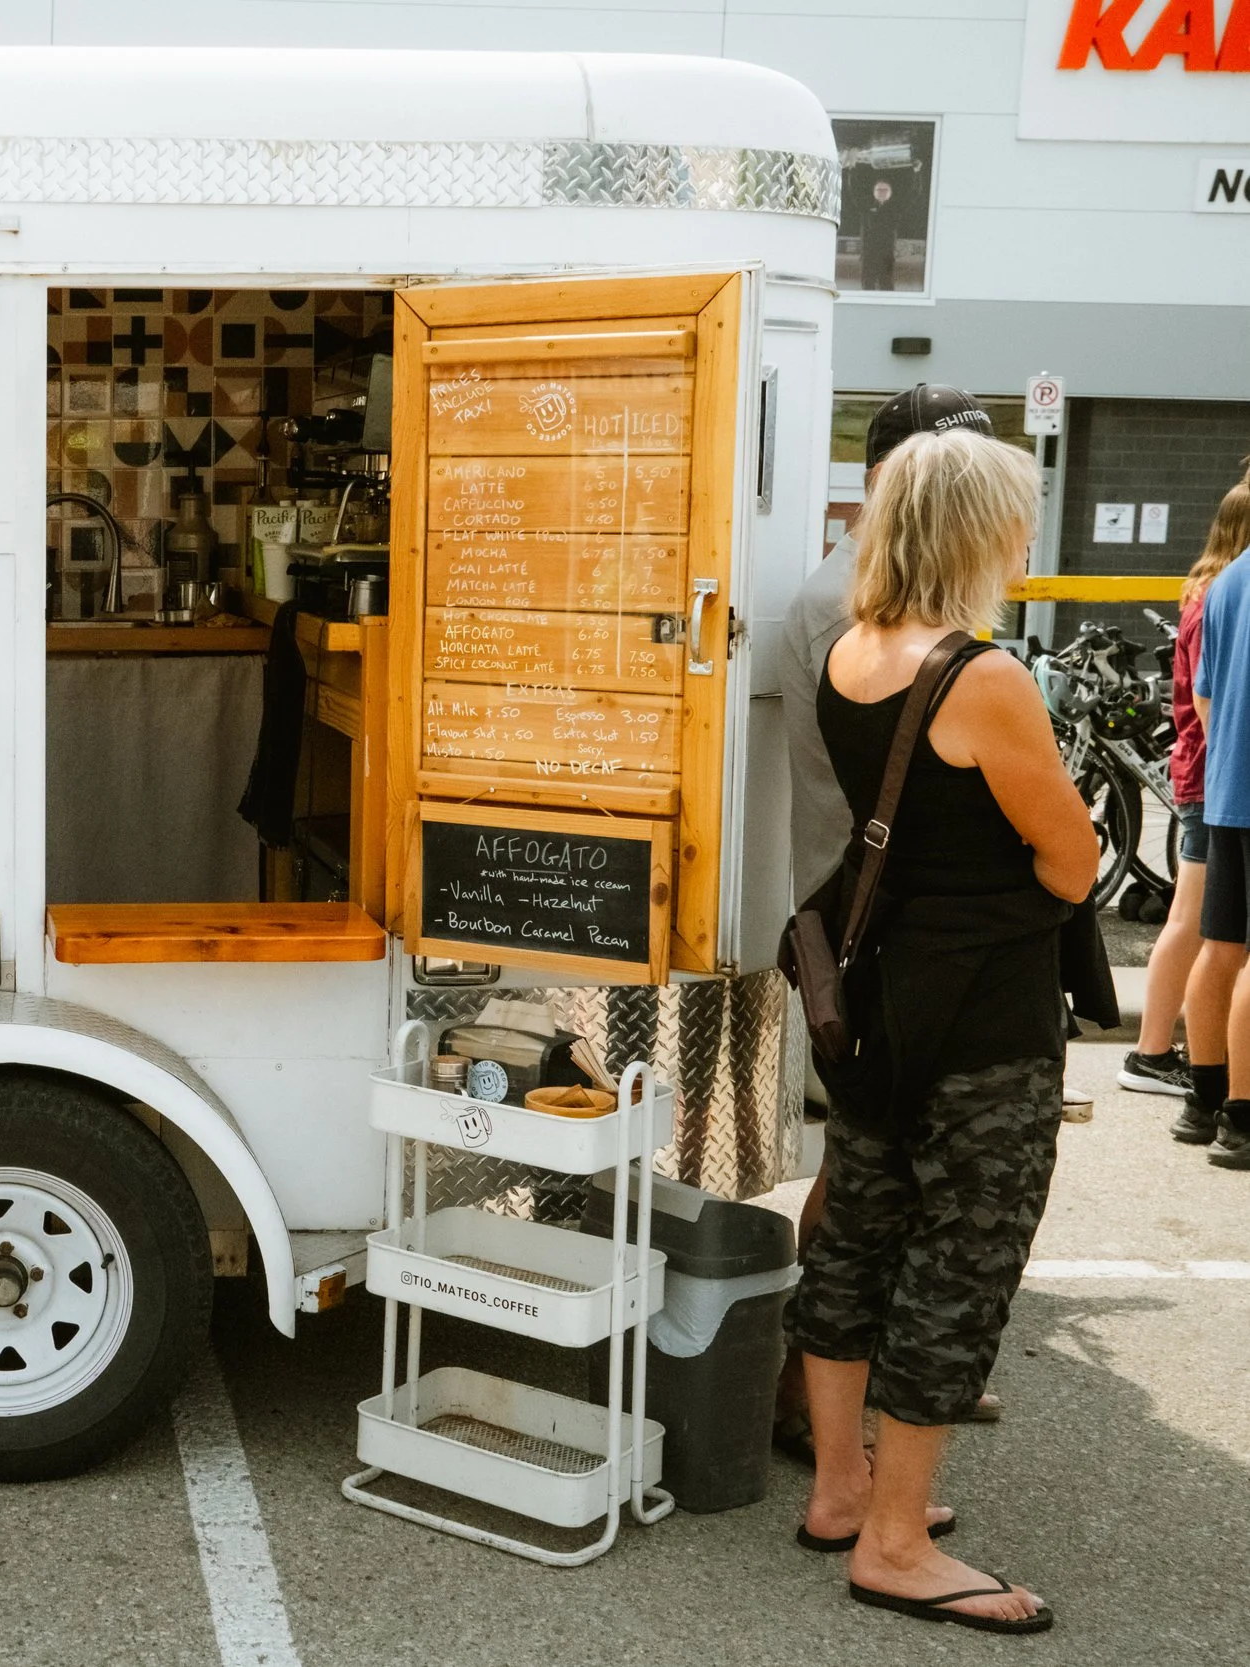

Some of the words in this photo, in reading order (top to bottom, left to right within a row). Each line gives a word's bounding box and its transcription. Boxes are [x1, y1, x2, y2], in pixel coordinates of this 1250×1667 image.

[1208, 168, 1250, 203] N
[430, 368, 481, 401] PRICES
[531, 383, 546, 395] TIO
[433, 380, 494, 416] INCLUDE
[453, 398, 492, 424] TAX!
[584, 414, 623, 435] HOT
[631, 412, 679, 436] ICED
[935, 410, 991, 430] SHIMA
[539, 424, 572, 441] COFFEE
[444, 465, 526, 480] AMERICANO
[595, 465, 607, 479] 5
[635, 465, 671, 479] 5.50
[642, 479, 654, 493] 7
[443, 497, 525, 512] CAPPUCCINO
[254, 509, 295, 525] Pacific
[453, 513, 521, 526] CORTADO
[585, 513, 614, 525] 4.50
[442, 528, 478, 541] FLAT
[485, 528, 526, 541] WHITE
[461, 547, 508, 559] MOCHA
[581, 548, 615, 559] 6.75
[632, 547, 666, 560] 7.50
[449, 563, 481, 575] CHAI
[592, 563, 601, 577] 6
[643, 565, 653, 579] 7
[446, 579, 497, 592] MATCHA
[630, 583, 661, 595] 7.50
[446, 595, 495, 607] LONDON
[506, 596, 530, 608] FOG
[580, 598, 611, 609] 5.50
[479, 611, 549, 625] CHOCOLATE
[445, 625, 514, 639] AFFOGATO
[578, 629, 609, 640] 6.50
[440, 640, 499, 654] HORCHATA
[572, 647, 602, 660] 6.75
[630, 650, 656, 663] 7.50
[434, 656, 465, 669] SPICY
[471, 659, 518, 670] COCONUT
[576, 664, 605, 675] 6.75
[630, 666, 657, 678] 7.50
[506, 682, 576, 700] EXTRAS
[452, 701, 478, 717] Milk
[556, 707, 605, 725] Espresso
[620, 710, 659, 724] 3.00
[427, 722, 468, 739] Flavour
[553, 726, 588, 739] Extra
[593, 728, 619, 742] Shot
[631, 730, 659, 743] 1.50
[427, 742, 462, 758] Misto
[536, 758, 560, 775] NO
[570, 759, 623, 775] DECAF
[476, 835, 607, 871] AFFOGATO
[570, 876, 588, 887] ice
[594, 880, 630, 891] cream
[521, 920, 575, 942] Caramel
[587, 926, 629, 949] Pecan
